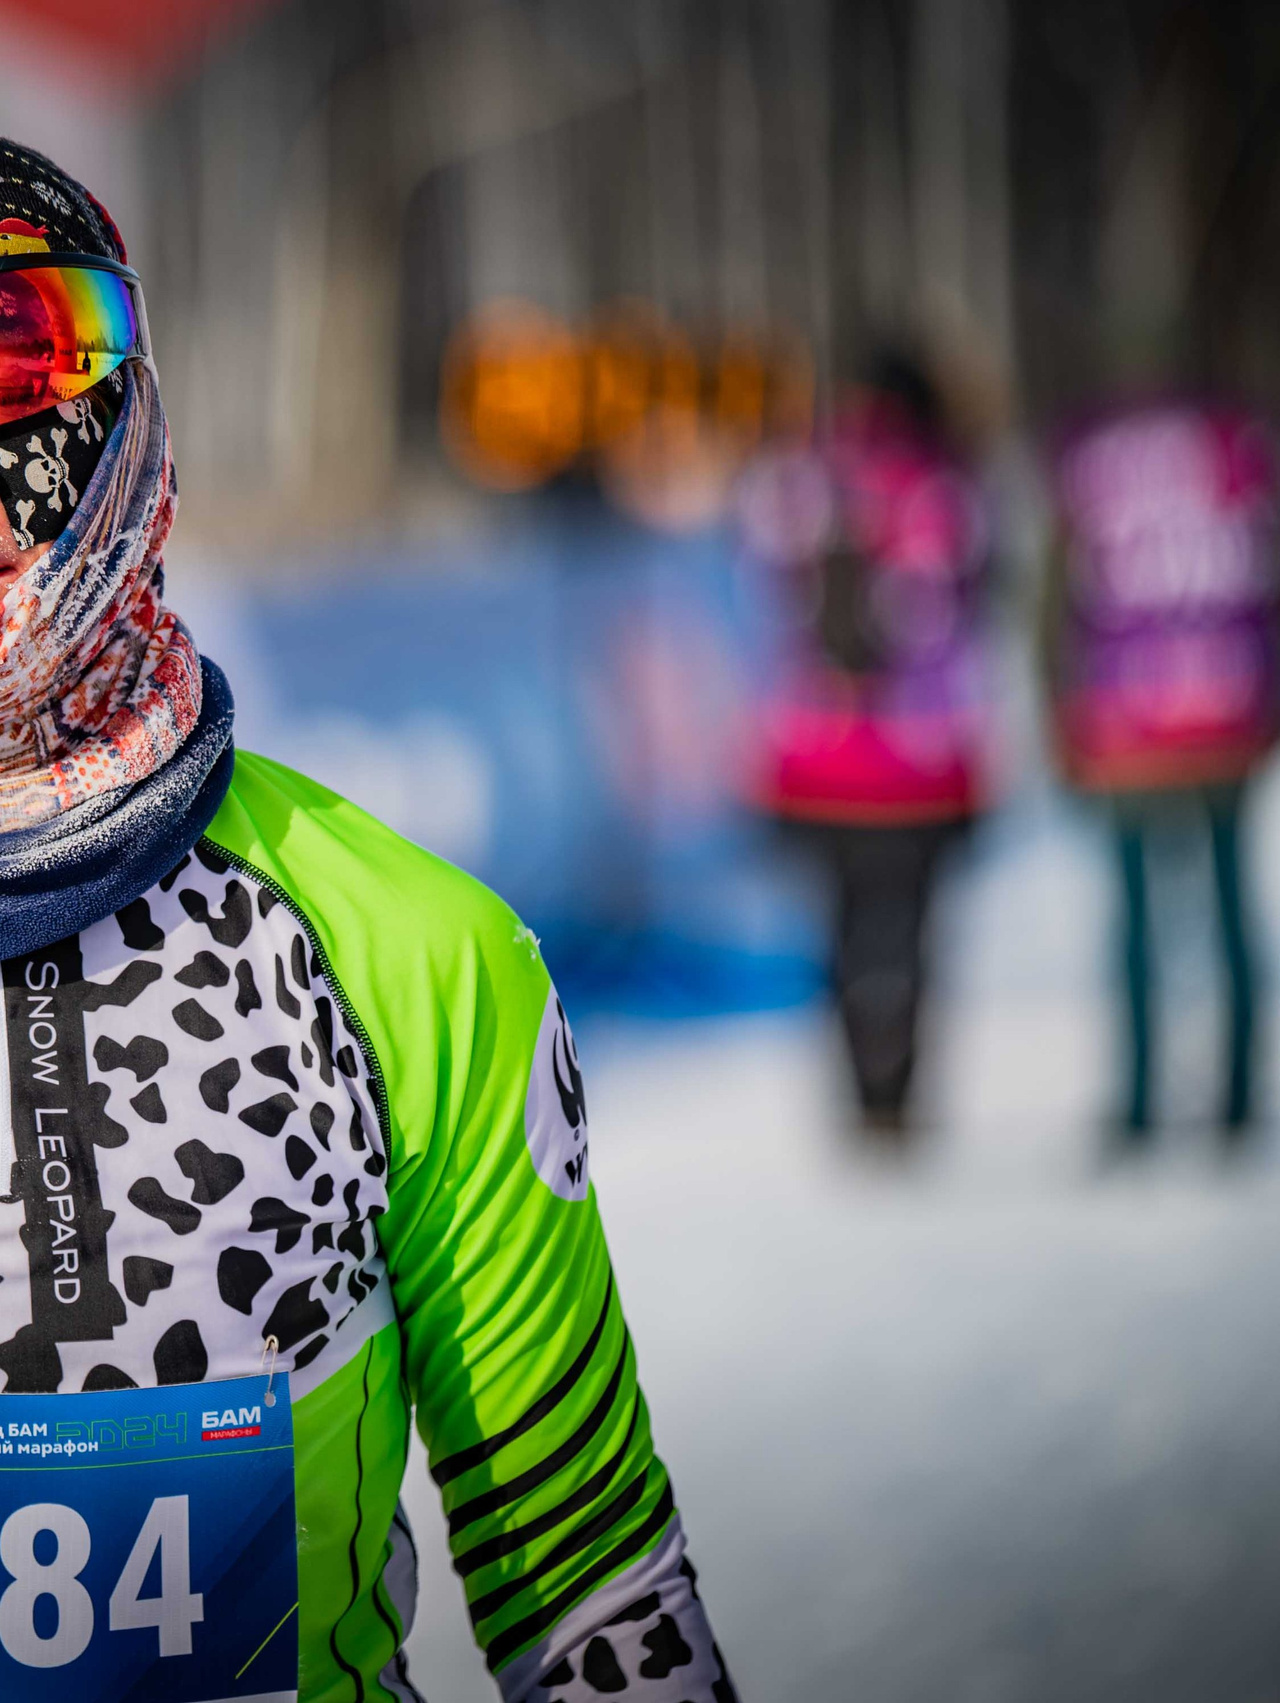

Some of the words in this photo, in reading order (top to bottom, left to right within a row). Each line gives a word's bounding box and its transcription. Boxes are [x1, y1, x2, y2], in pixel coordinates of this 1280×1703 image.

[24, 961, 60, 1085] SNOW
[34, 1108, 82, 1305] LEOPARD
[202, 1406, 261, 1428] БАМ
[8, 1423, 47, 1437] БАМ
[18, 1440, 99, 1457] марафон
